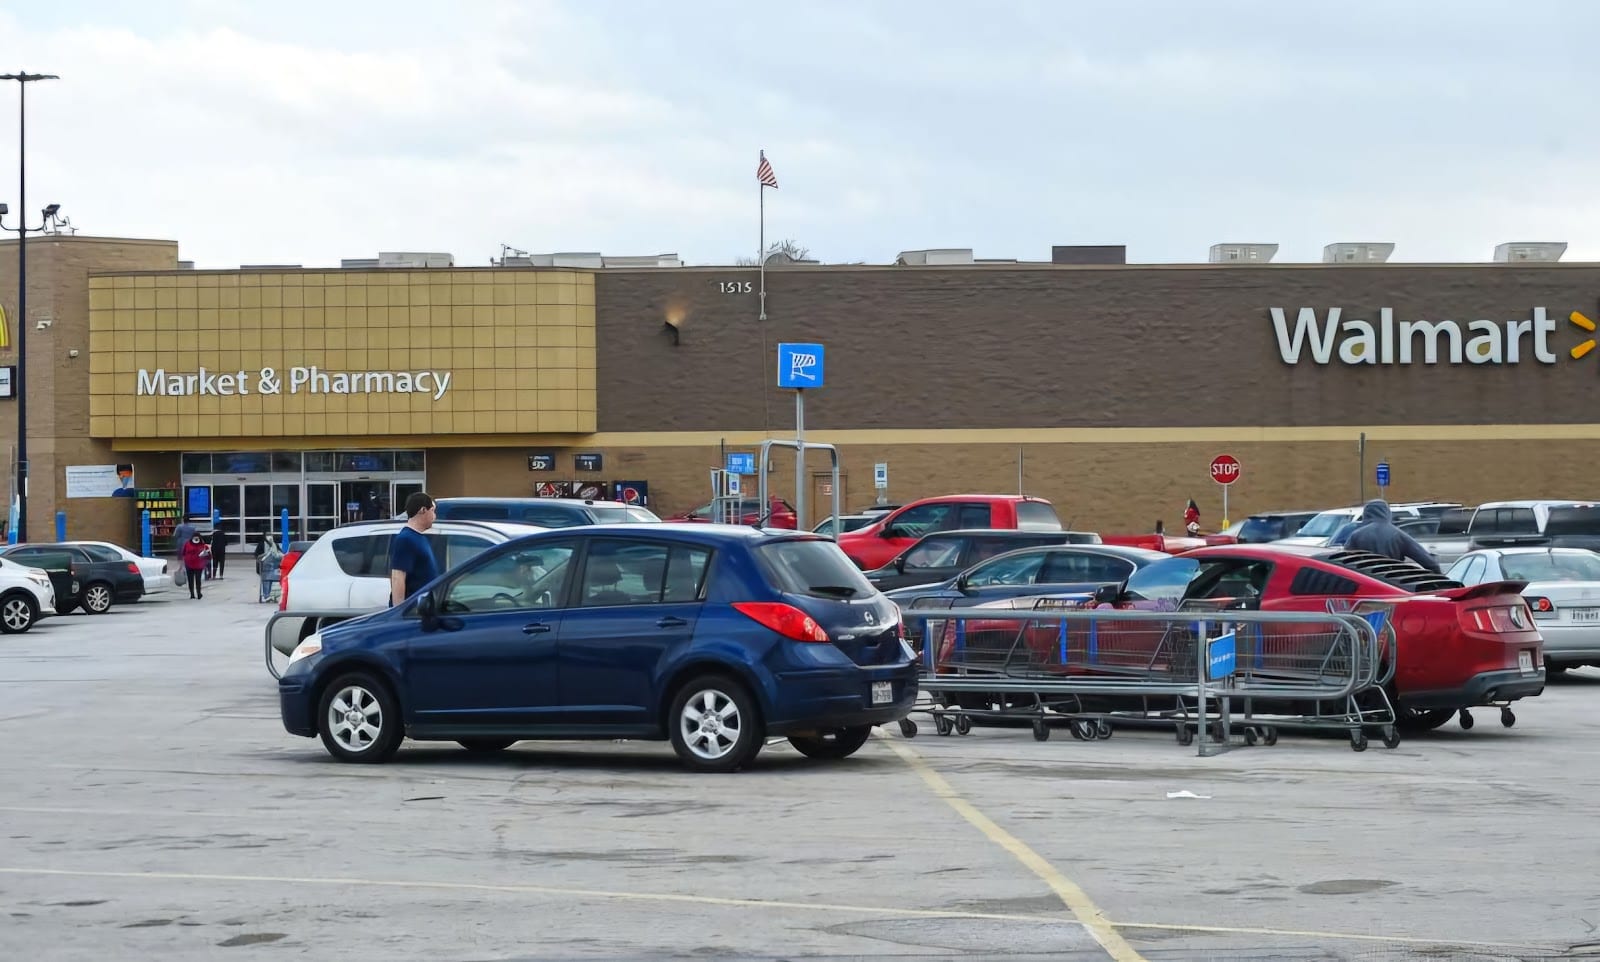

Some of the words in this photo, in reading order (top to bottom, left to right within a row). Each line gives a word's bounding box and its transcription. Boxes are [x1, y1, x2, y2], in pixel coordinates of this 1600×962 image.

[1269, 306, 1556, 365] Walmart
[136, 366, 249, 396] Market
[257, 366, 281, 395] &
[290, 365, 451, 401] Pharmacy
[1212, 463, 1239, 475] STOP
